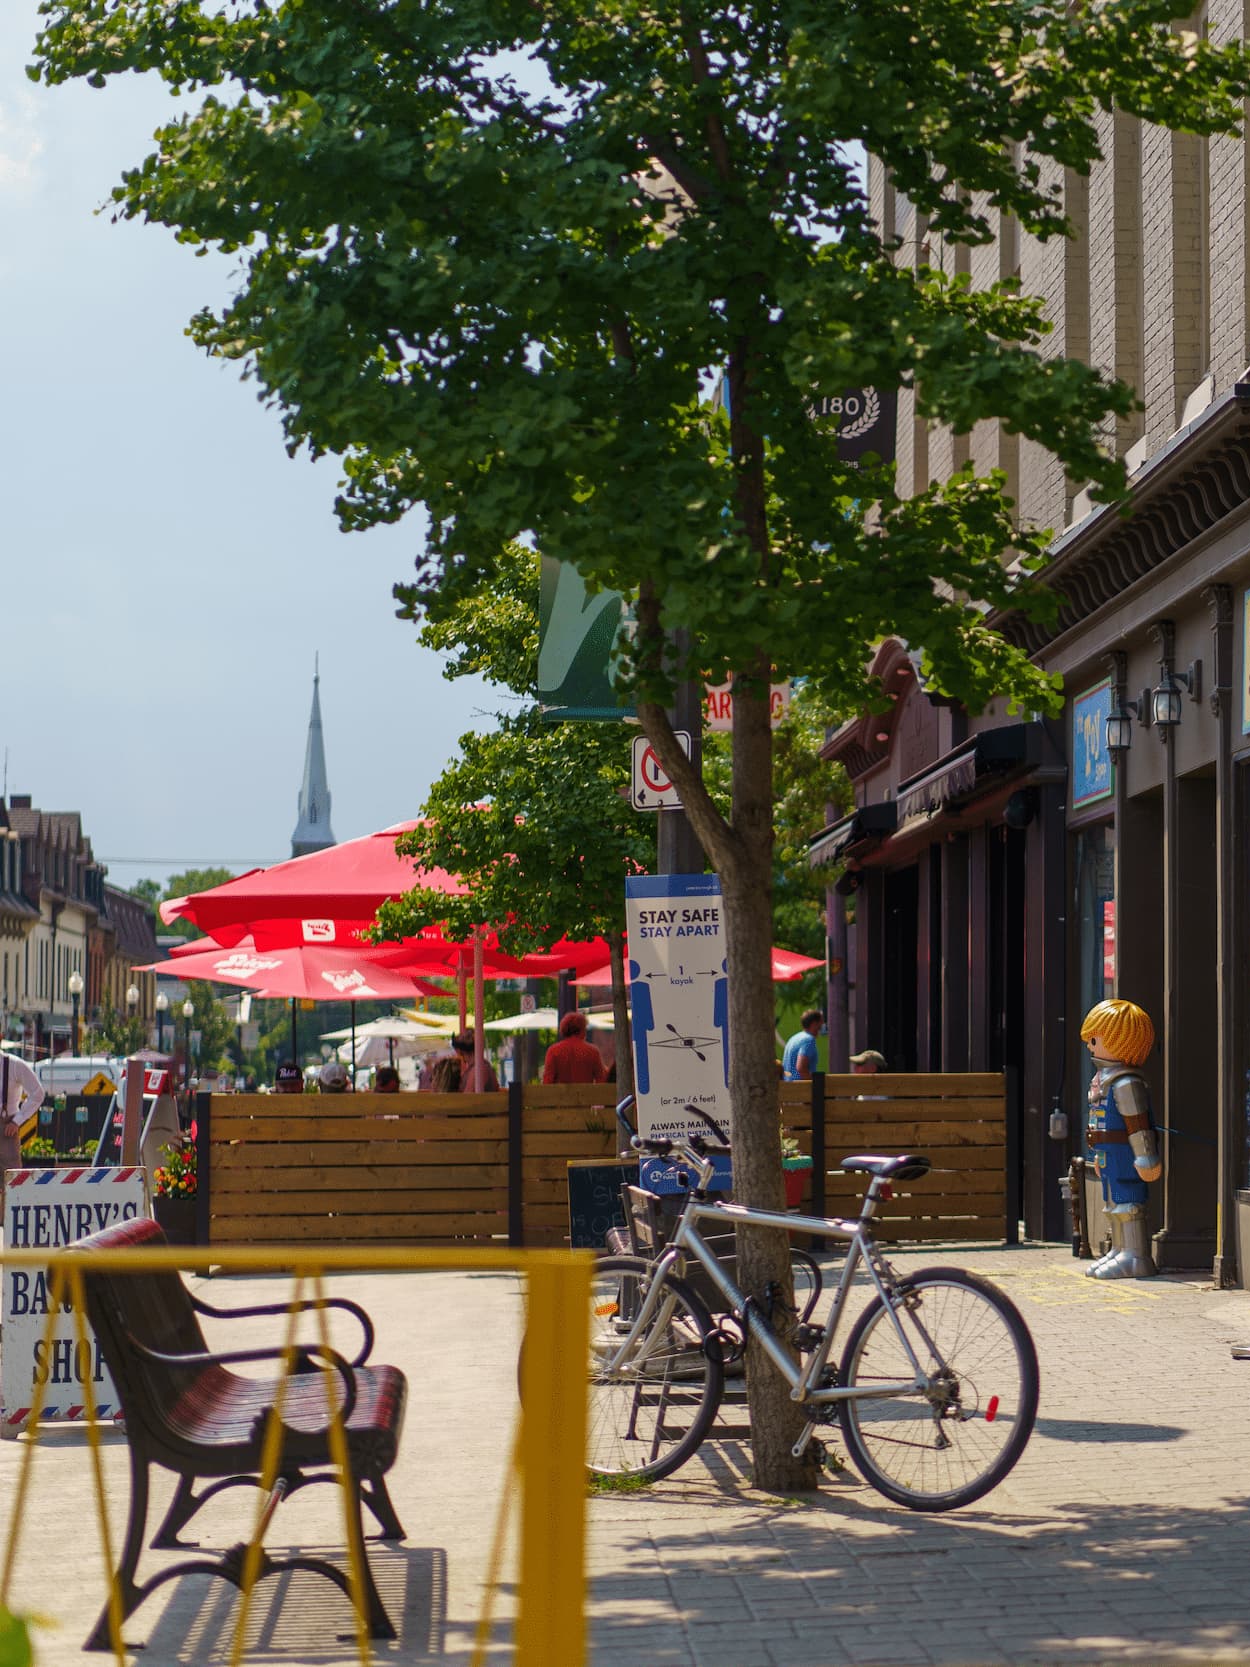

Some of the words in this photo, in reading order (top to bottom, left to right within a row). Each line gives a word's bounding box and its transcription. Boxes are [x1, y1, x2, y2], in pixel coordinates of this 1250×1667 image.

[639, 910, 677, 924] STAY
[682, 908, 719, 923] SAFE
[640, 926, 671, 938] STAY
[676, 924, 719, 937] APART
[679, 965, 684, 975] 1
[670, 977, 694, 987] kayak
[673, 1096, 685, 1104] 2m
[651, 1121, 685, 1131] ALWAYS
